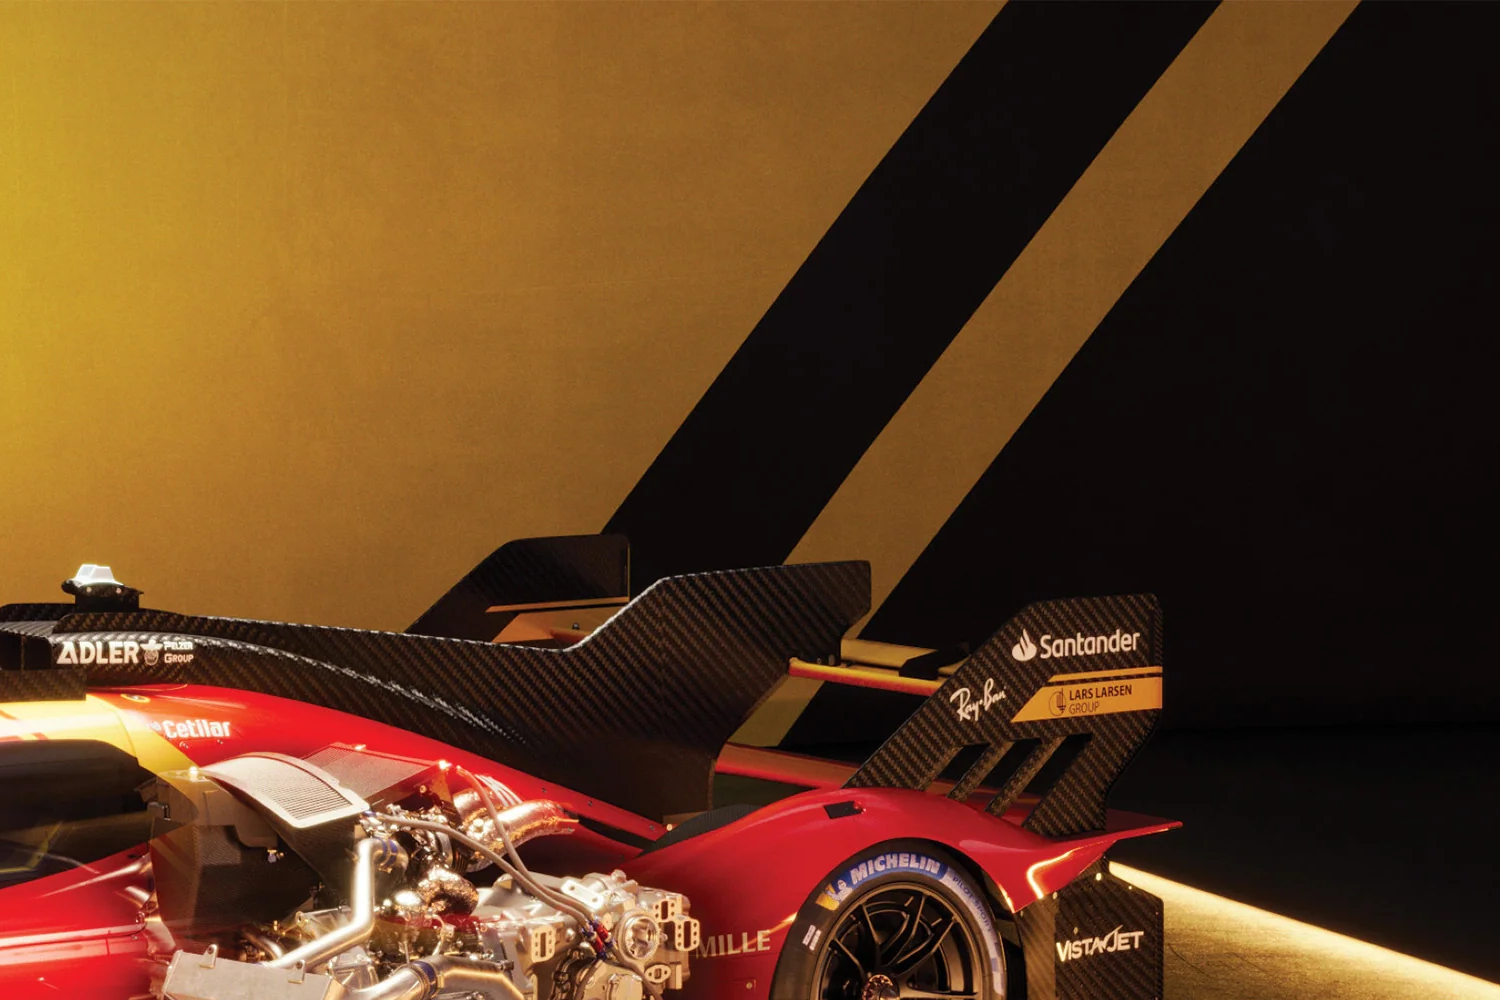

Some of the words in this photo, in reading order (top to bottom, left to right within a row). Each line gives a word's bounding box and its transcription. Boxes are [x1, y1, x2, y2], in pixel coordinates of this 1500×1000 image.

[56, 641, 139, 665] ADLER
[163, 641, 193, 651] PELZER
[1039, 628, 1140, 659] Santander
[164, 653, 194, 664] GROUP
[1069, 687, 1094, 701] LARS
[1095, 684, 1133, 699] LARSEN
[1069, 701, 1100, 715] GROUP
[161, 719, 231, 739] Cetilar
[850, 853, 941, 885] MICHELIN
[696, 929, 771, 959] MILLE
[1056, 925, 1144, 962] VISTAJET
